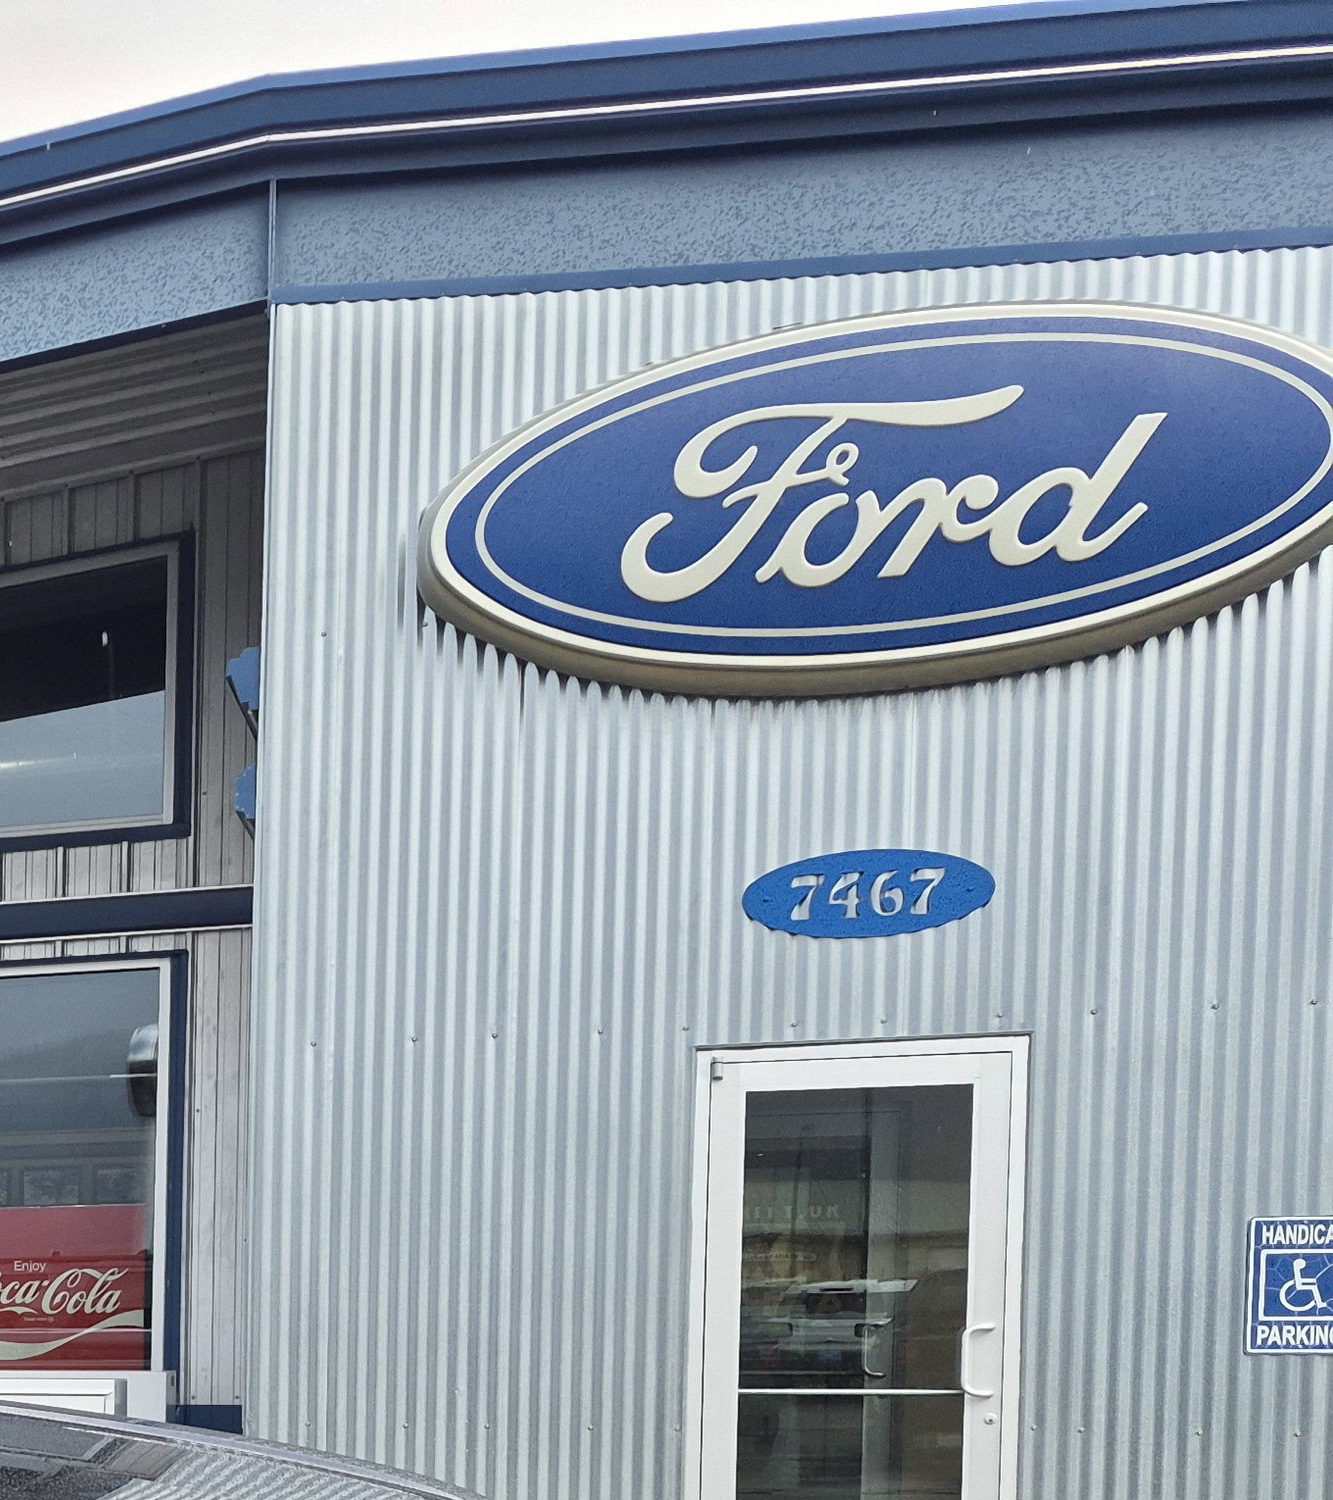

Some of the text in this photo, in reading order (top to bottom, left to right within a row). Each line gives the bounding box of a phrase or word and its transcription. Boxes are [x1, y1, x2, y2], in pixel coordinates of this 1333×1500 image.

[621, 384, 1167, 602] Ford
[789, 866, 947, 921] 7467
[13, 1260, 47, 1273] Enjoy
